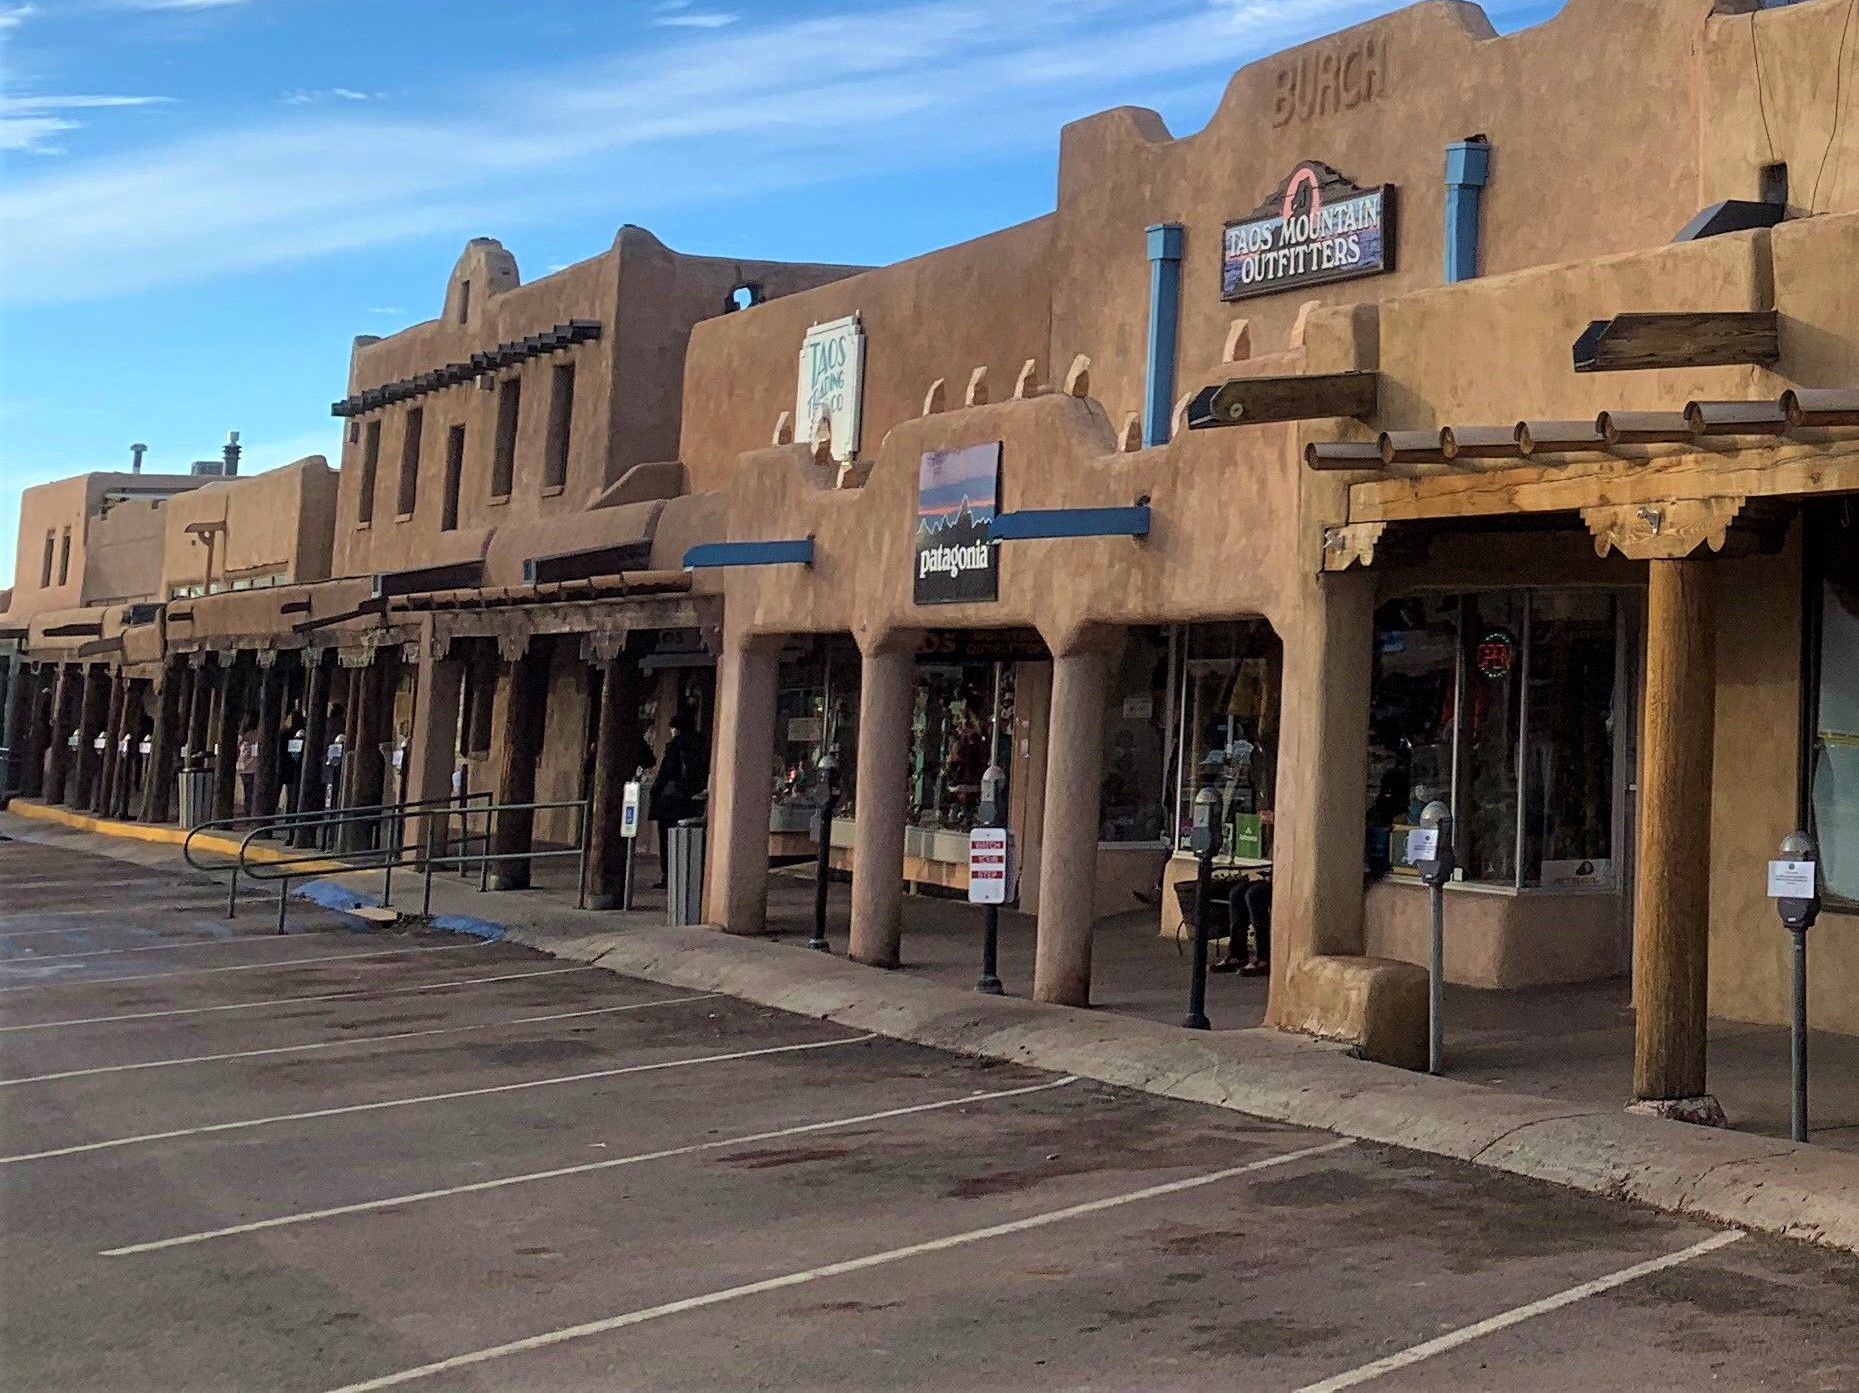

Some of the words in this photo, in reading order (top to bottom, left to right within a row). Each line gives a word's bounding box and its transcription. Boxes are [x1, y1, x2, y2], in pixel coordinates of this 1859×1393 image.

[1229, 224, 1273, 257] TAOS
[1279, 198, 1378, 247] MOUNTAIN
[1241, 235, 1361, 283] OUTFITTERS
[810, 336, 846, 392] TAOS
[919, 538, 988, 578] patagonia
[978, 871, 997, 879] STEP
